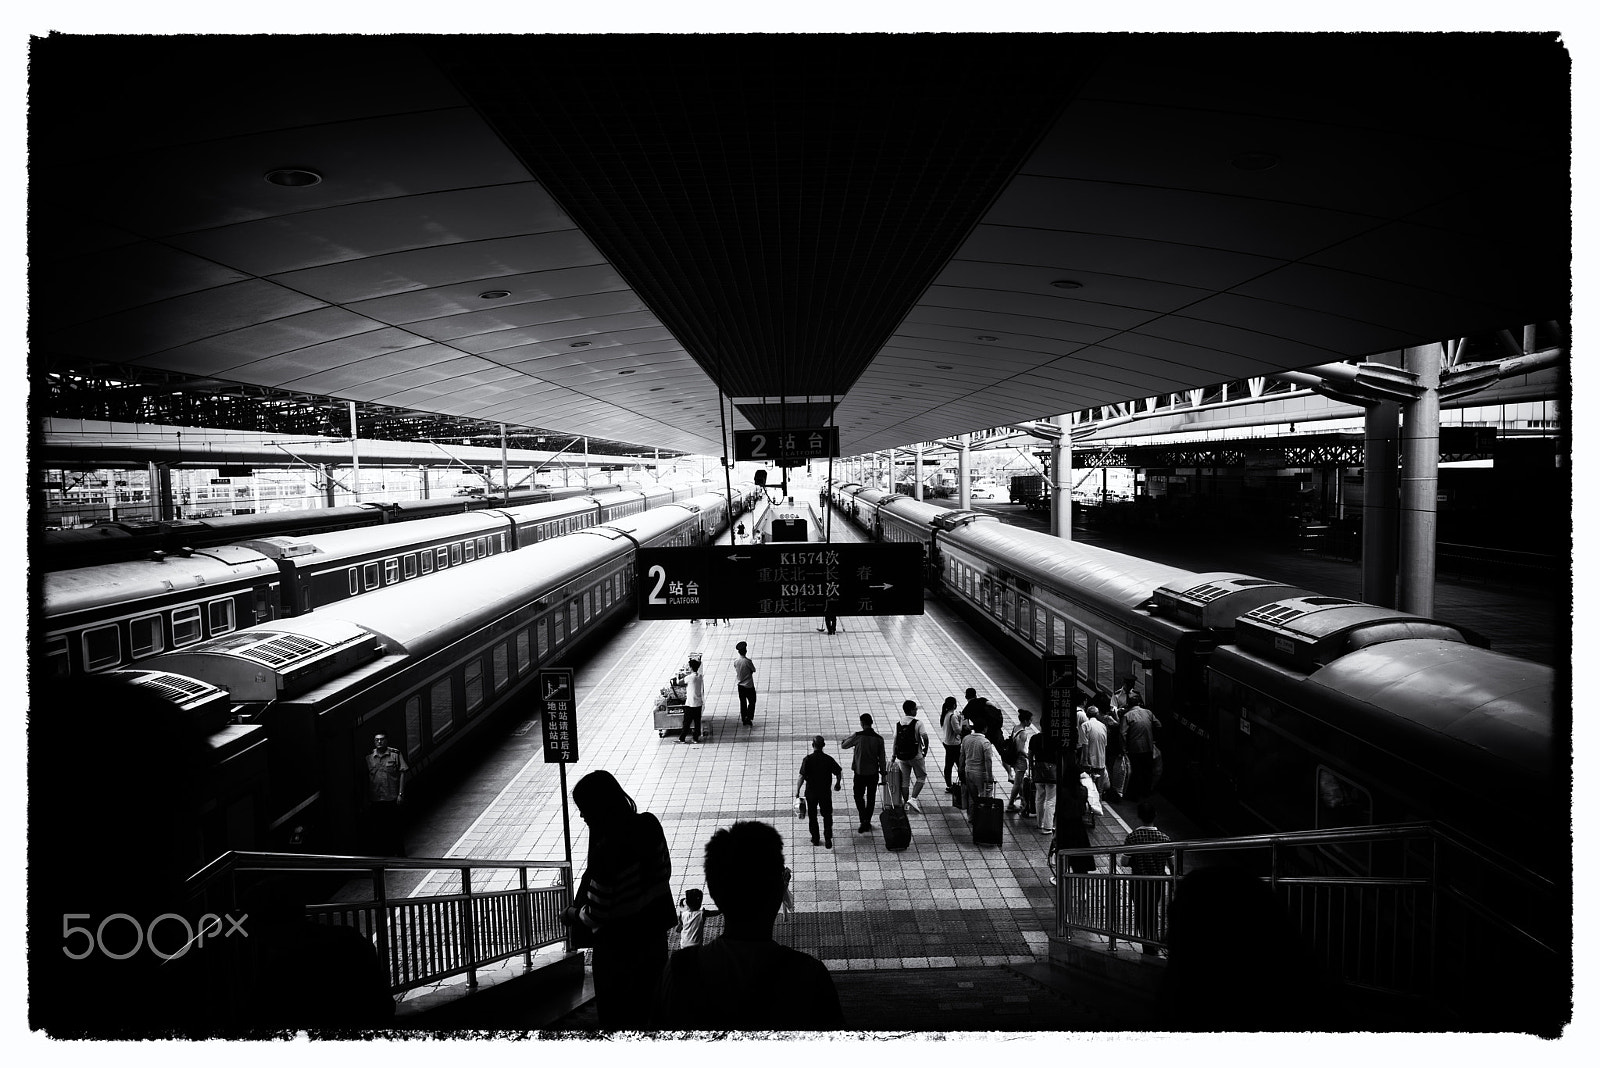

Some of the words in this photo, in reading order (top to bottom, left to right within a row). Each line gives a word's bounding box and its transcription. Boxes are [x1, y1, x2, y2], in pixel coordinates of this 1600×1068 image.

[750, 434, 768, 458] 2
[778, 432, 823, 450] 站台
[780, 551, 840, 565] K1574次
[856, 566, 873, 581] 春
[648, 564, 667, 605] 2
[668, 580, 699, 596] 站台
[781, 582, 840, 597] K9431次
[668, 596, 699, 605] PLATFORM
[857, 598, 873, 612] 元
[547, 702, 559, 750] 地下出站口
[558, 702, 570, 760] 出站请走后方
